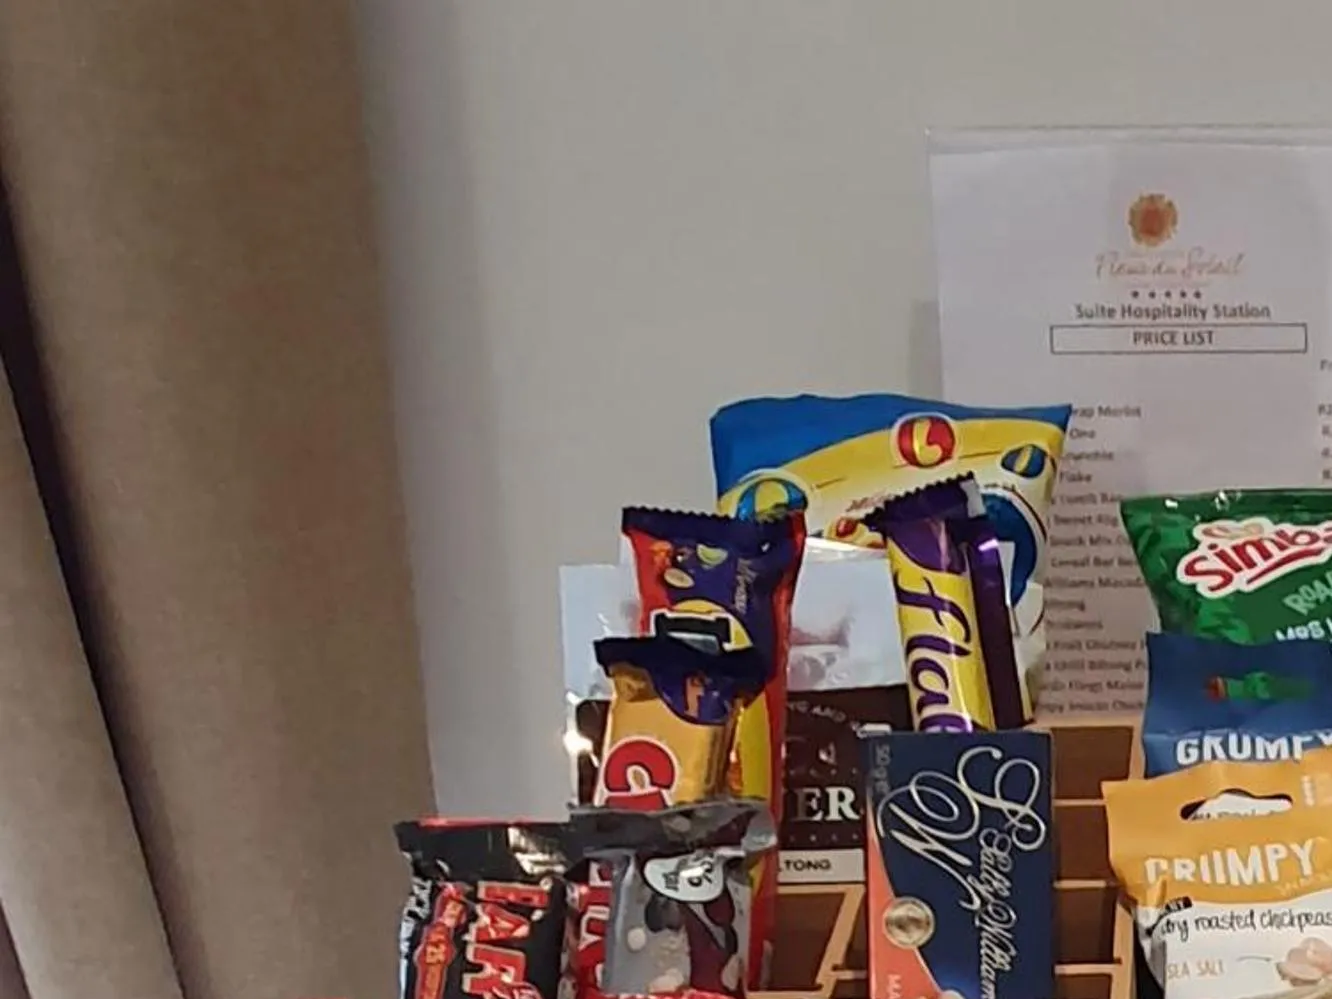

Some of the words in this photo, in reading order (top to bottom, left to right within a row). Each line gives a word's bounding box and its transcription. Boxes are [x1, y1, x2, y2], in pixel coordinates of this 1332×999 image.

[1075, 303, 1116, 319] Suite
[1121, 304, 1207, 321] Hospitality
[1213, 303, 1271, 319] Station
[1133, 330, 1176, 345] PRICE
[1183, 330, 1214, 345] LIST
[779, 858, 832, 872] TONG
[1194, 909, 1257, 932] roasted
[1166, 963, 1190, 980] SEA
[1197, 959, 1224, 977] SALT
